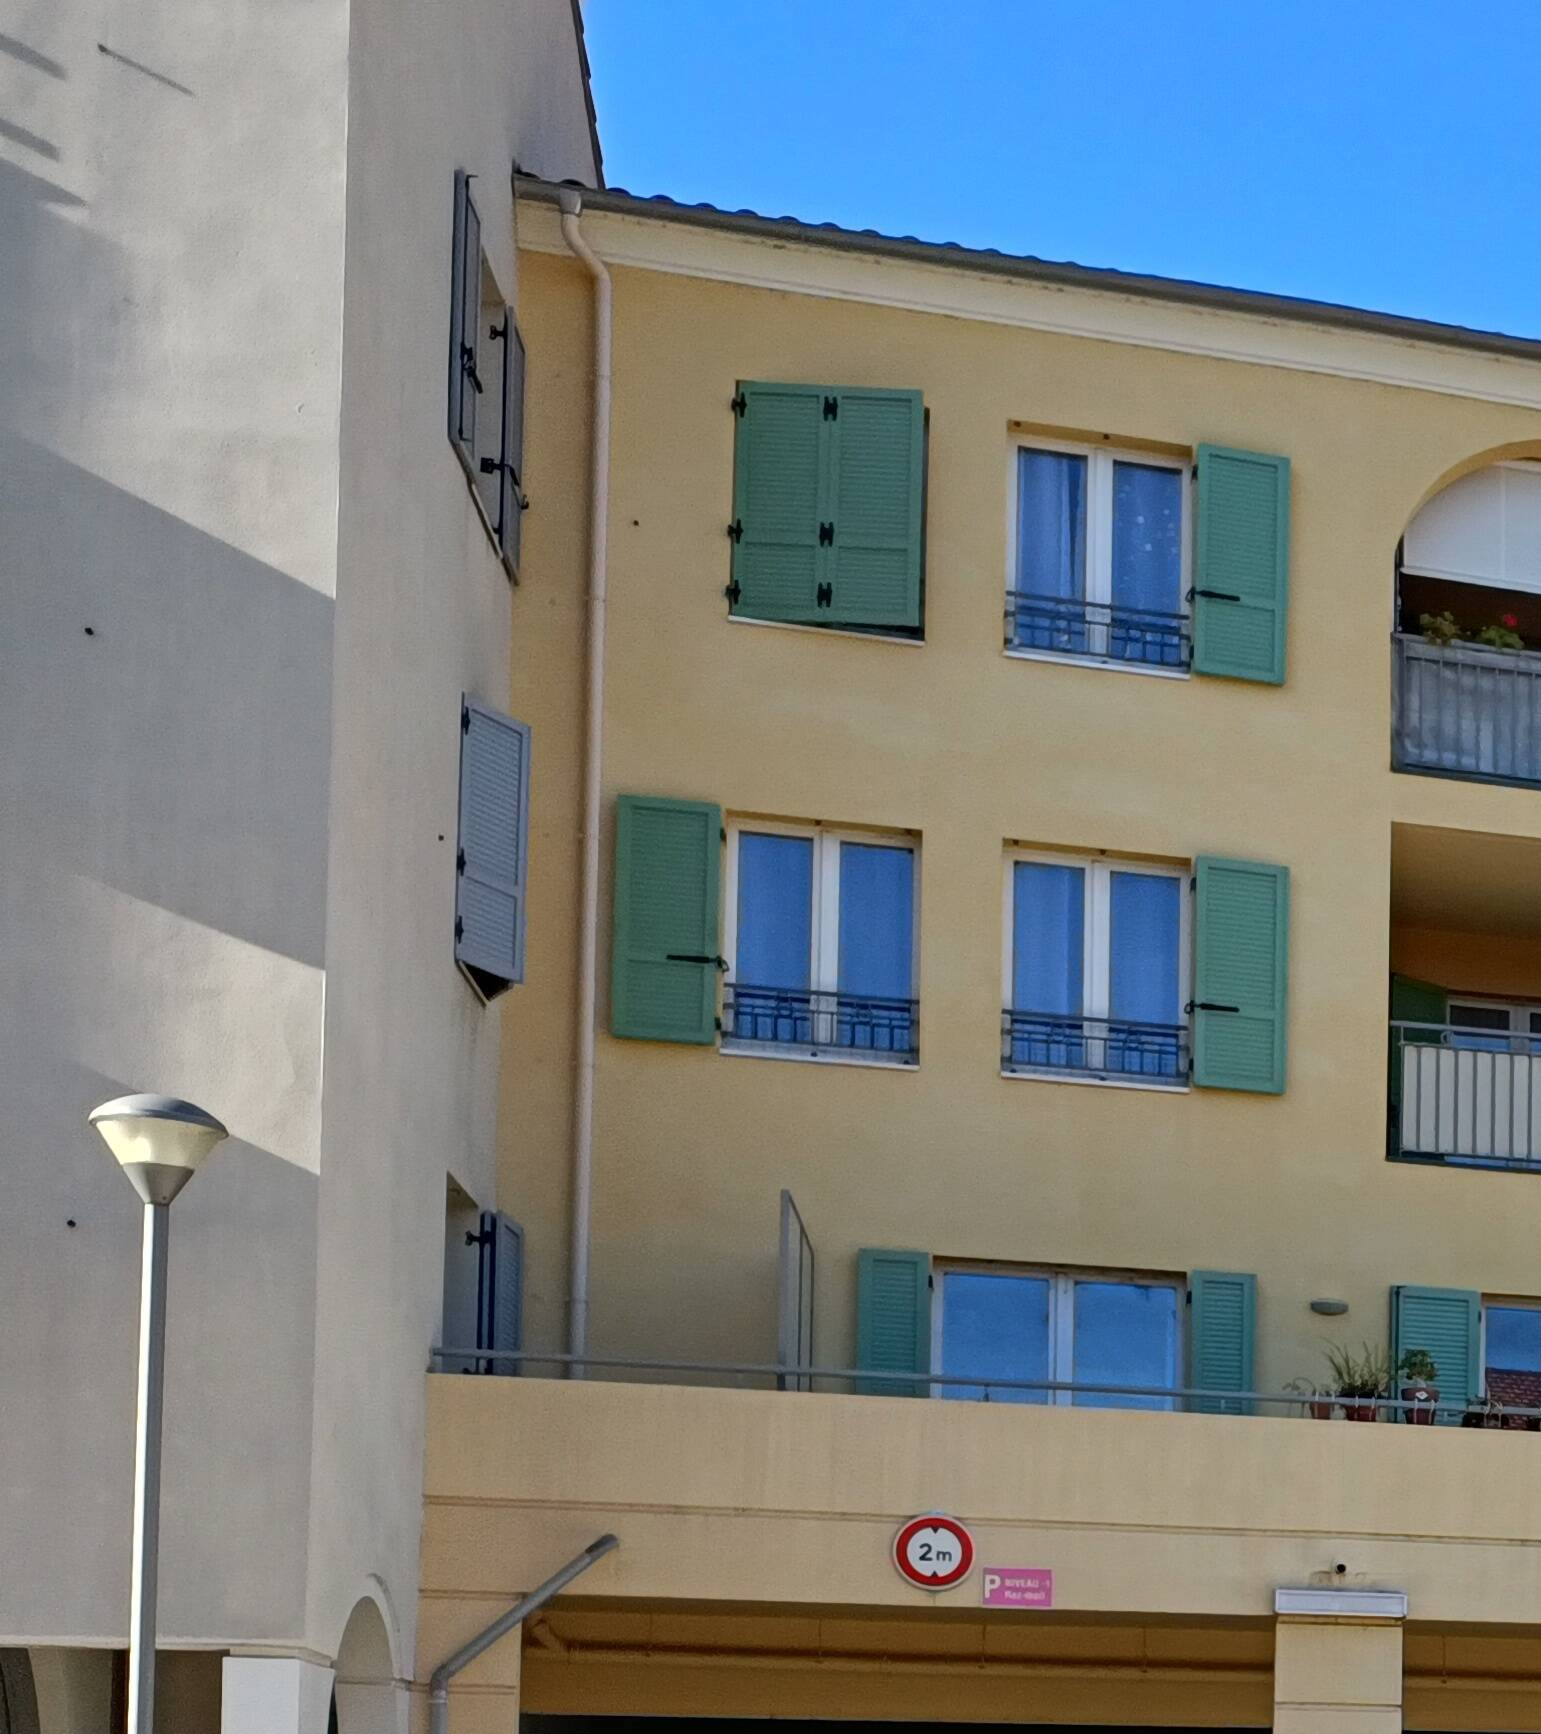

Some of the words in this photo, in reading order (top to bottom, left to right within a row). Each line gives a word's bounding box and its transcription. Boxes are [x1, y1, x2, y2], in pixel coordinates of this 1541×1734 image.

[919, 1543, 933, 1562] 2
[936, 1549, 953, 1562] m
[984, 1574, 1001, 1599] P
